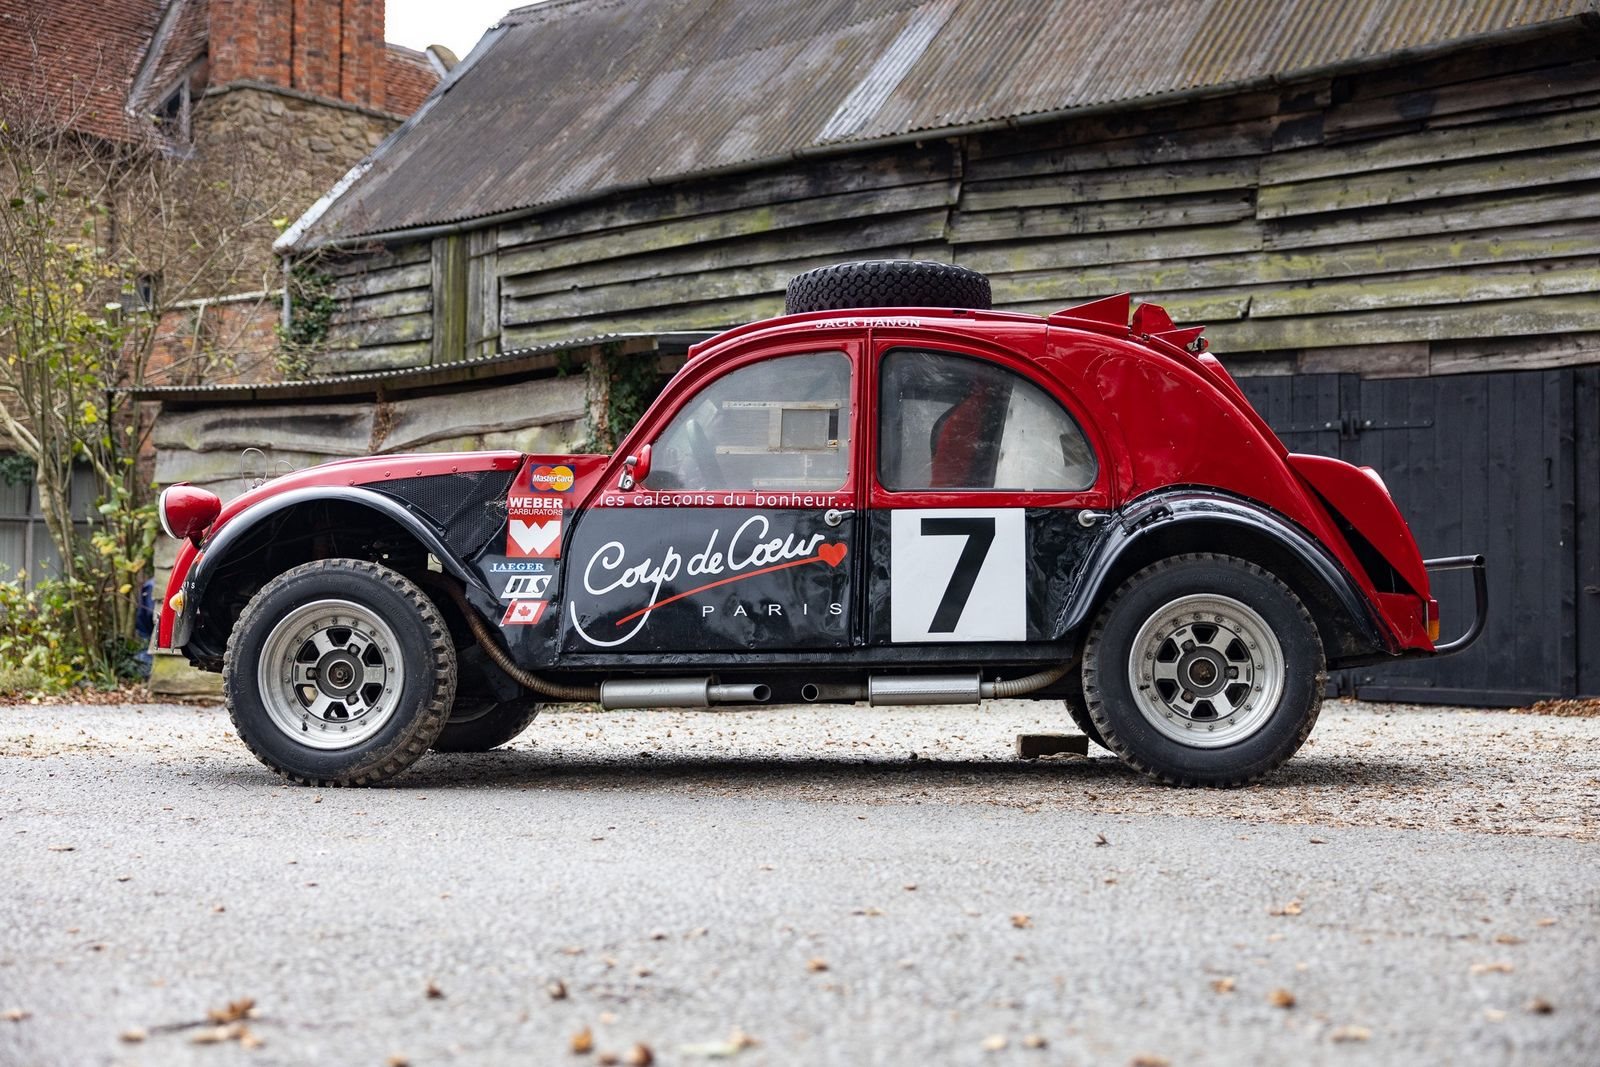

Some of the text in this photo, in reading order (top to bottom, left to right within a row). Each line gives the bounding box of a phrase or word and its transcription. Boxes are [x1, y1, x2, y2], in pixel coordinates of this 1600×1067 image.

[816, 318, 920, 328] JACK HANON
[532, 474, 574, 483] MasterCard
[510, 497, 563, 508] WEBER
[600, 492, 625, 506] les
[633, 492, 715, 507] caleçons
[723, 492, 746, 506] du
[508, 508, 563, 516] CARBURATORS
[489, 562, 545, 572] JAEGER
[920, 517, 996, 633] 7
[570, 541, 682, 646] Coup
[686, 528, 725, 576] de
[701, 603, 843, 617] PARIS
